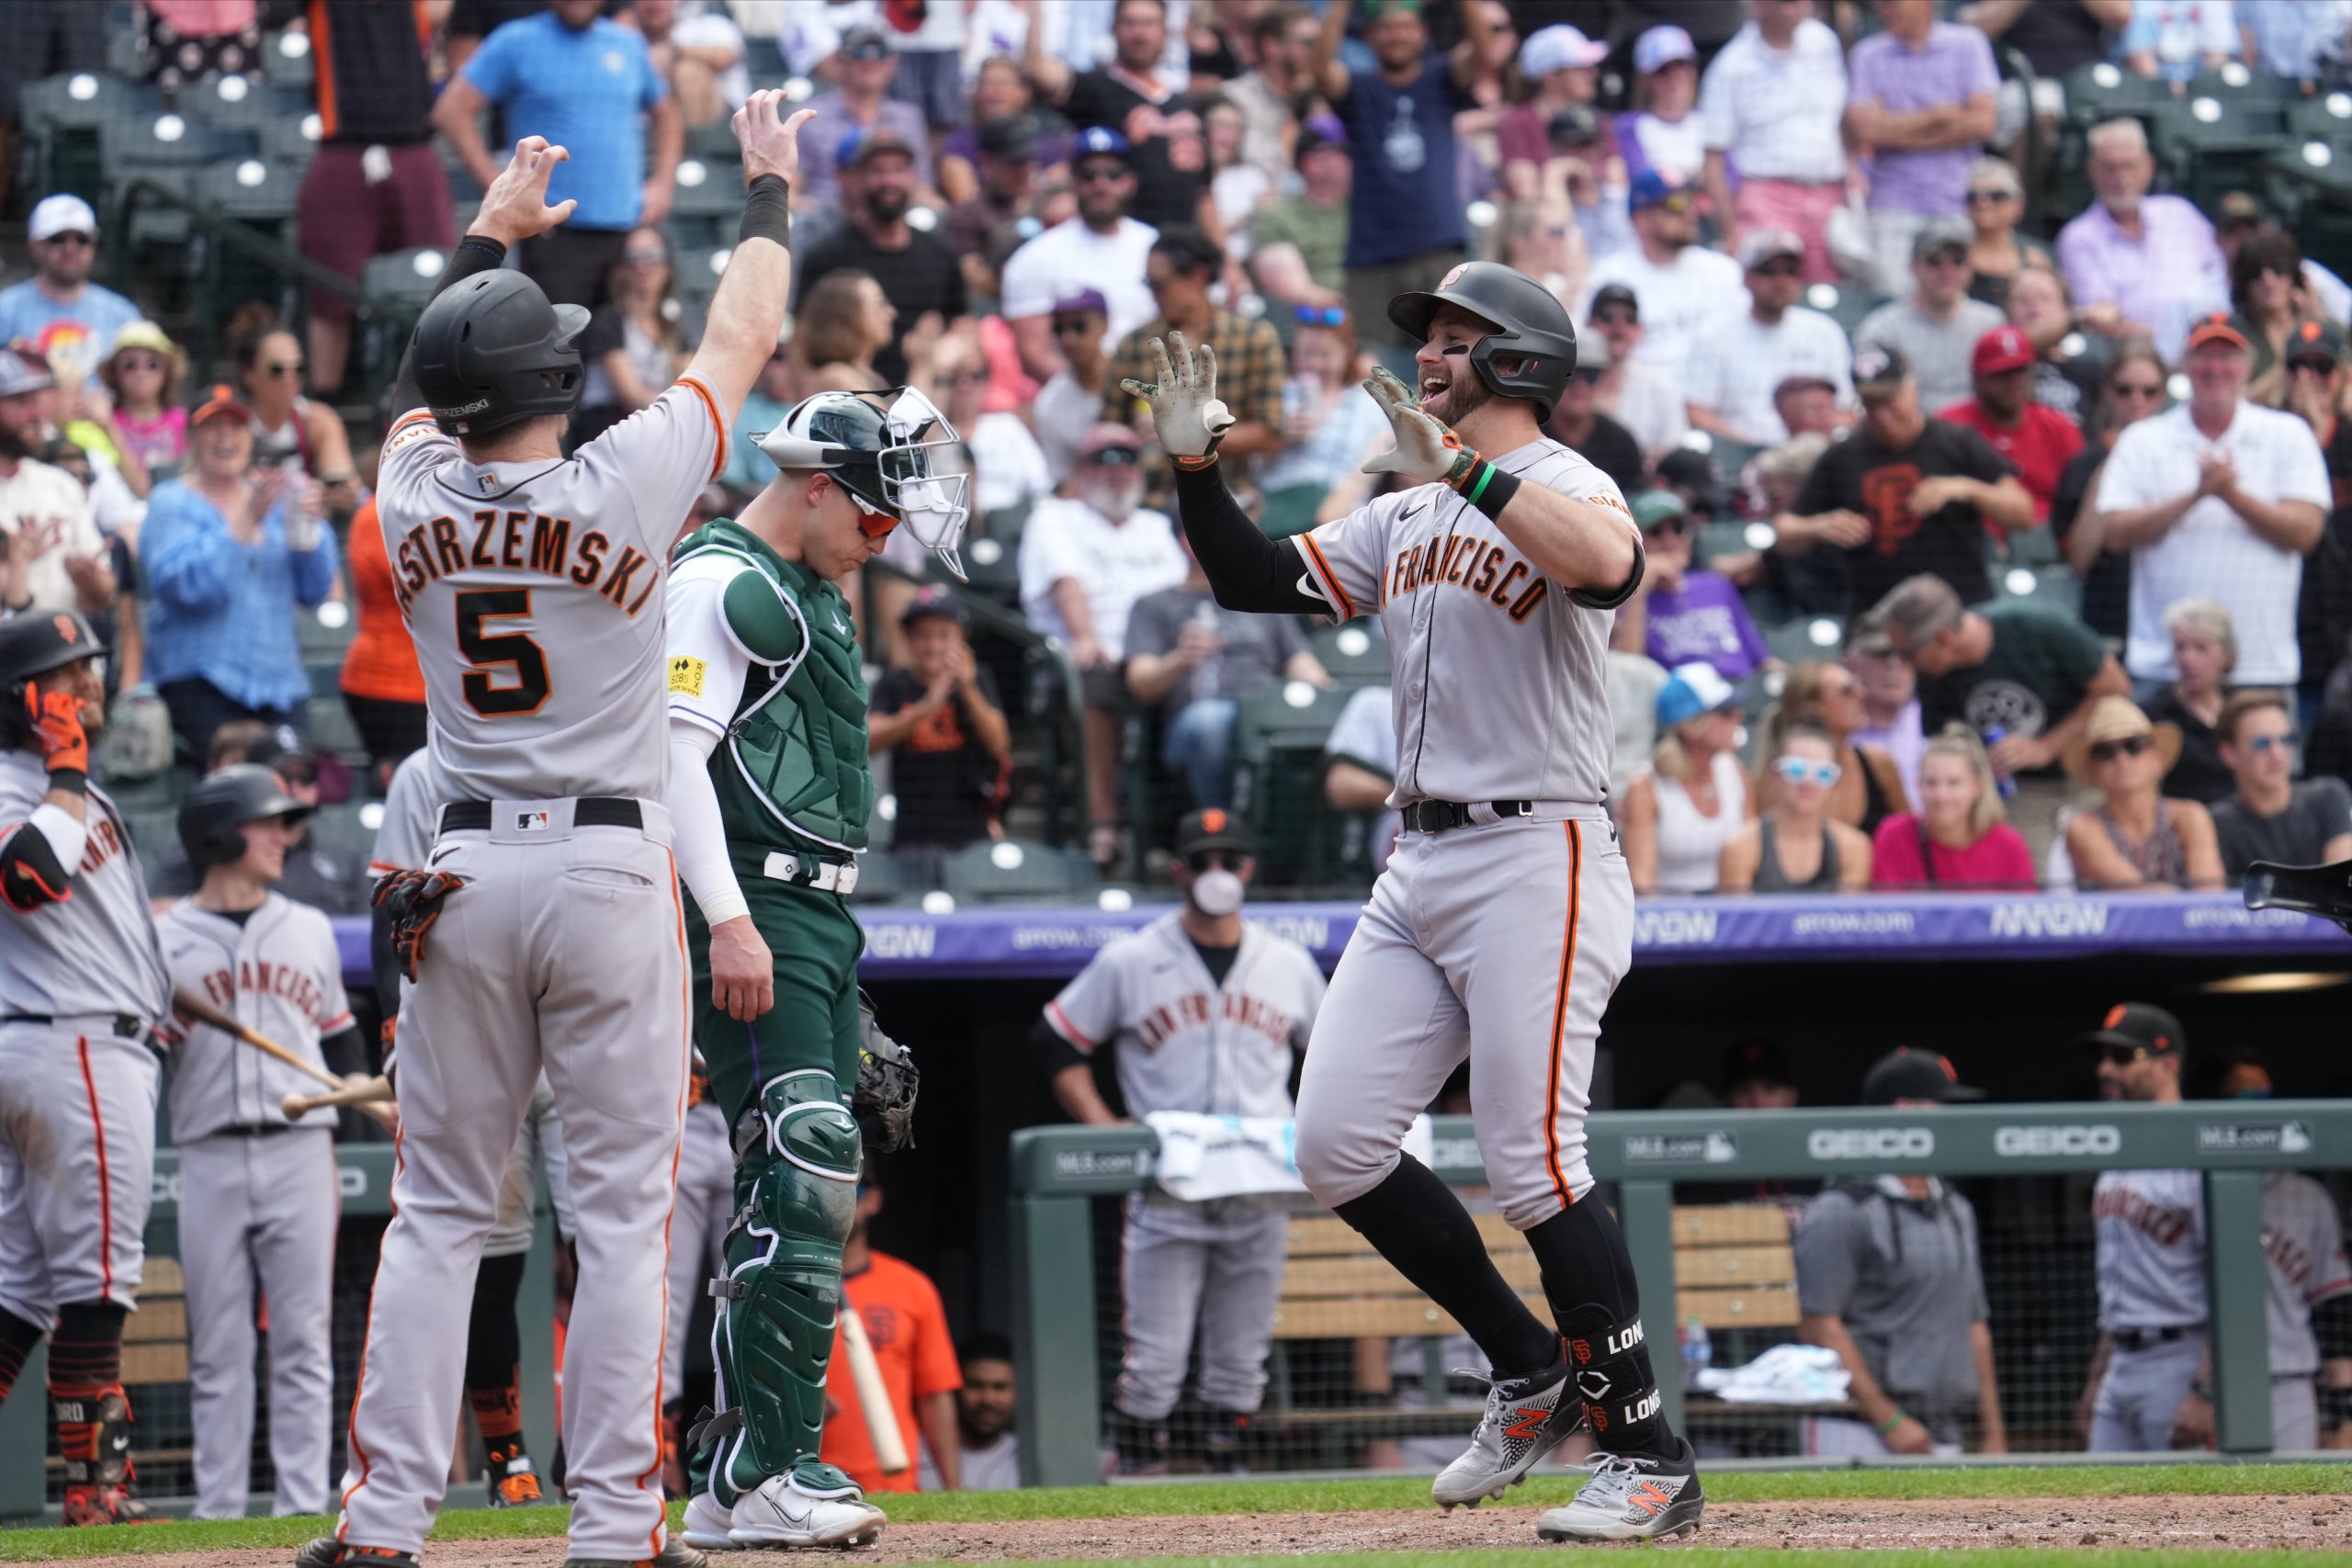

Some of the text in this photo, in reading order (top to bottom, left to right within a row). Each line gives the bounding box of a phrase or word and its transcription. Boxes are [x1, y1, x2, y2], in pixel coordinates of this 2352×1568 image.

[1392, 535, 1548, 625] FRANCISCO
[455, 587, 552, 717] 5
[1807, 1129, 1935, 1160] GEICO
[1995, 1125, 2121, 1156] GEICO
